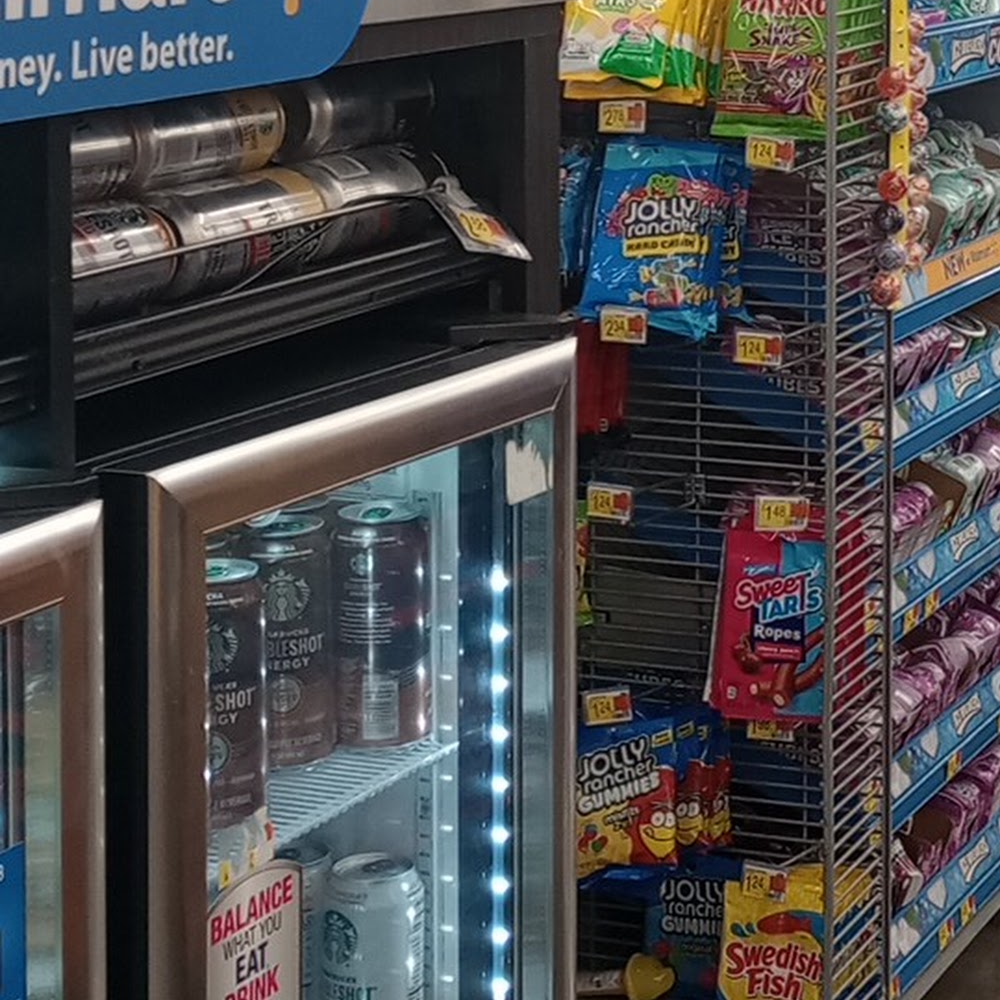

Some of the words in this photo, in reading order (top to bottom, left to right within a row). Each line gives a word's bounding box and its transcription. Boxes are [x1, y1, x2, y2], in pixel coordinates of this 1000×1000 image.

[71, 37, 137, 80] Live
[140, 31, 235, 71] better.
[624, 198, 699, 224] JOLLY
[627, 219, 698, 237] rancher
[627, 241, 659, 251] HARD
[753, 625, 801, 641] Ropes
[580, 738, 647, 783] JOLLY
[584, 758, 653, 795] rancher
[578, 771, 661, 815] GUMMIES
[211, 875, 294, 946] BALANCE
[223, 933, 257, 960] WHAT
[257, 912, 284, 944] YOU
[235, 942, 269, 985] EAT
[726, 942, 825, 981] Swedish
[746, 966, 801, 1000] Fish
